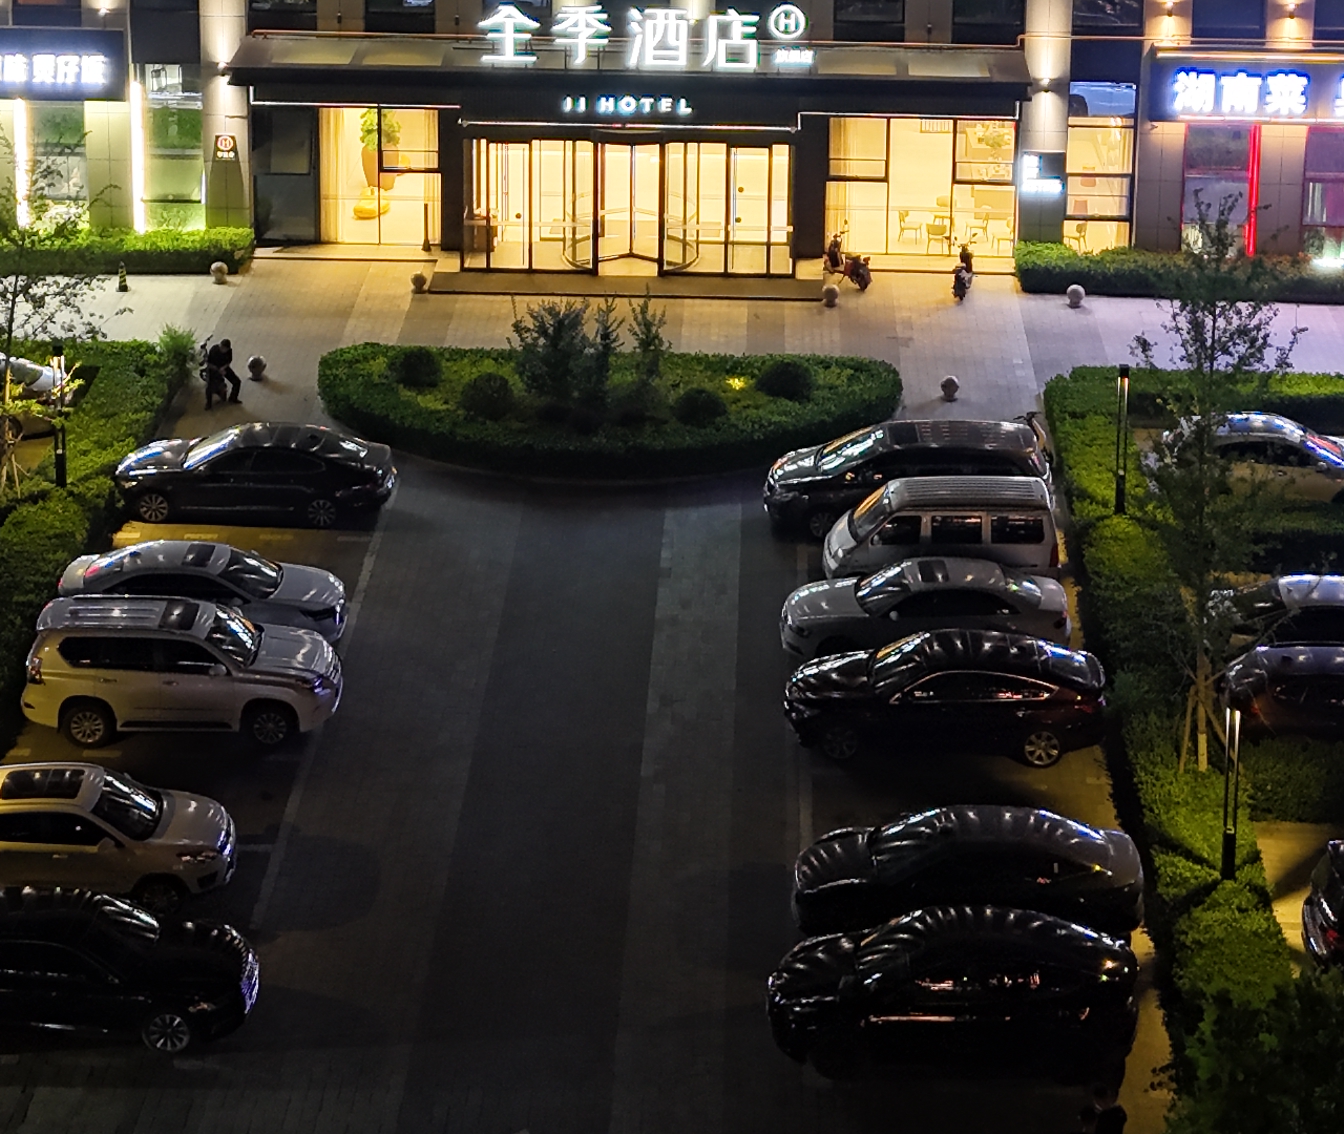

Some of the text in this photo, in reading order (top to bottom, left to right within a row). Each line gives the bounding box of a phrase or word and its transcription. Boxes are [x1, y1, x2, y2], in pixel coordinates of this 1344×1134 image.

[478, 3, 760, 69] 全季酒店
[597, 94, 693, 114] HOTEL
[1173, 71, 1308, 115] 湖南菜
